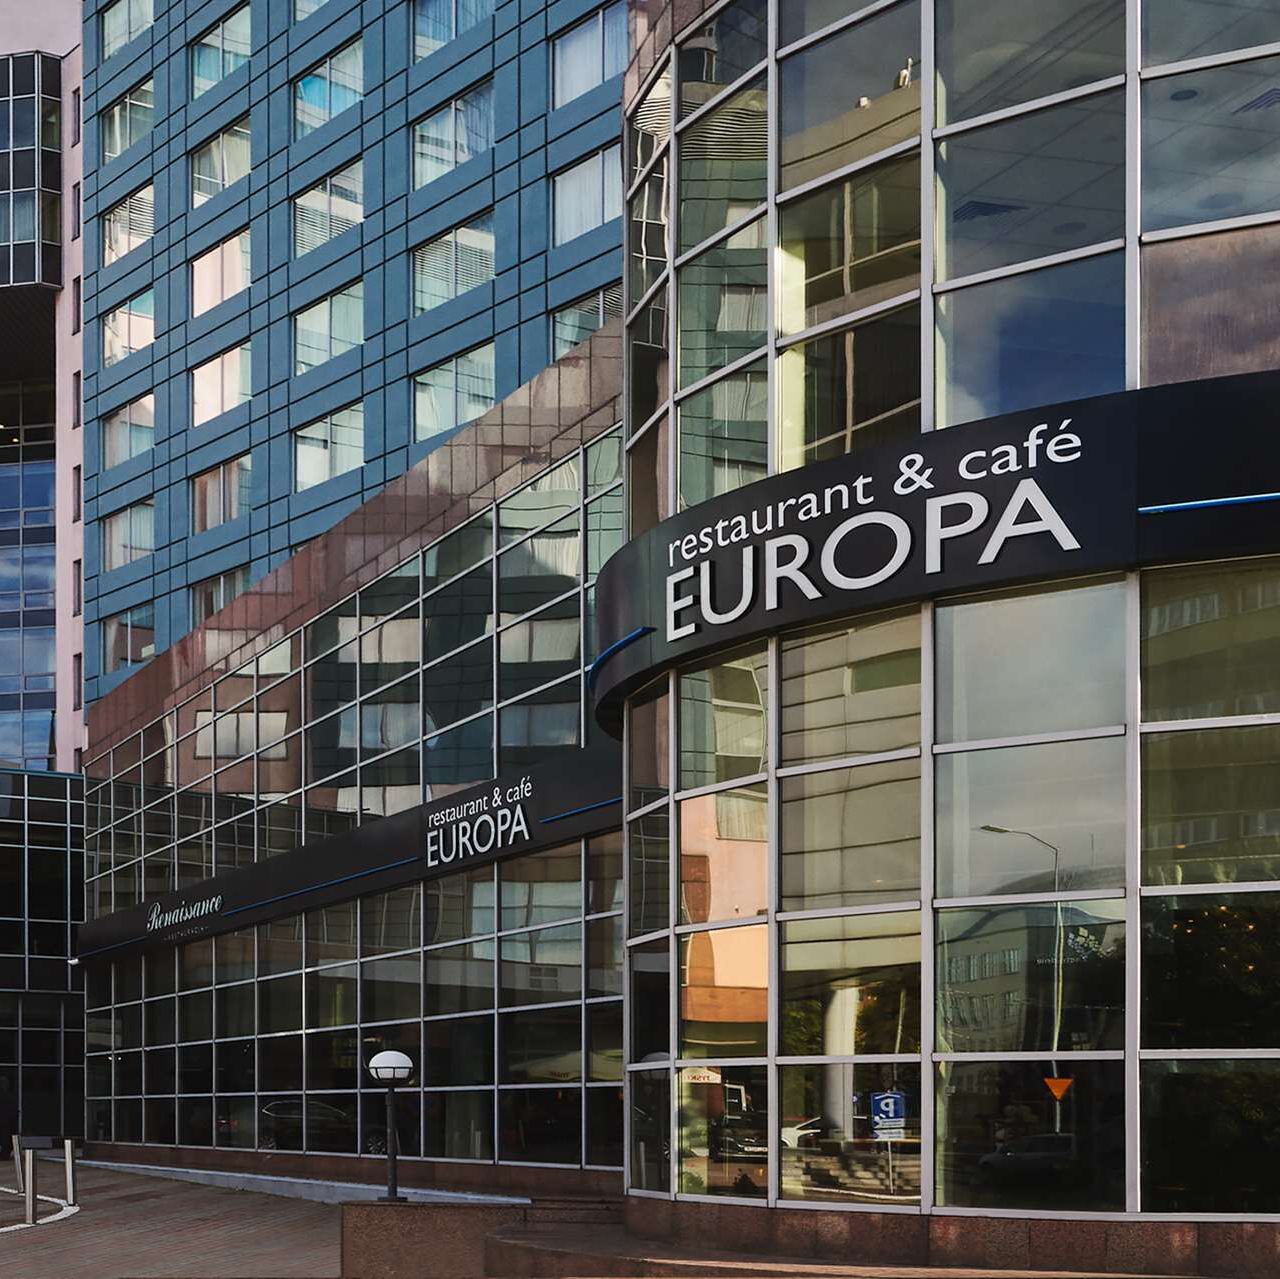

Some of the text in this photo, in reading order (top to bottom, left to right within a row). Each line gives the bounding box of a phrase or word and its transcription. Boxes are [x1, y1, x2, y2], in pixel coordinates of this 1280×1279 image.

[668, 418, 1083, 568] restaurant & café
[665, 477, 1082, 643] EUROPA
[428, 775, 533, 828] restaurant & café
[426, 803, 530, 868] EUROPA
[147, 895, 222, 933] Renaissance
